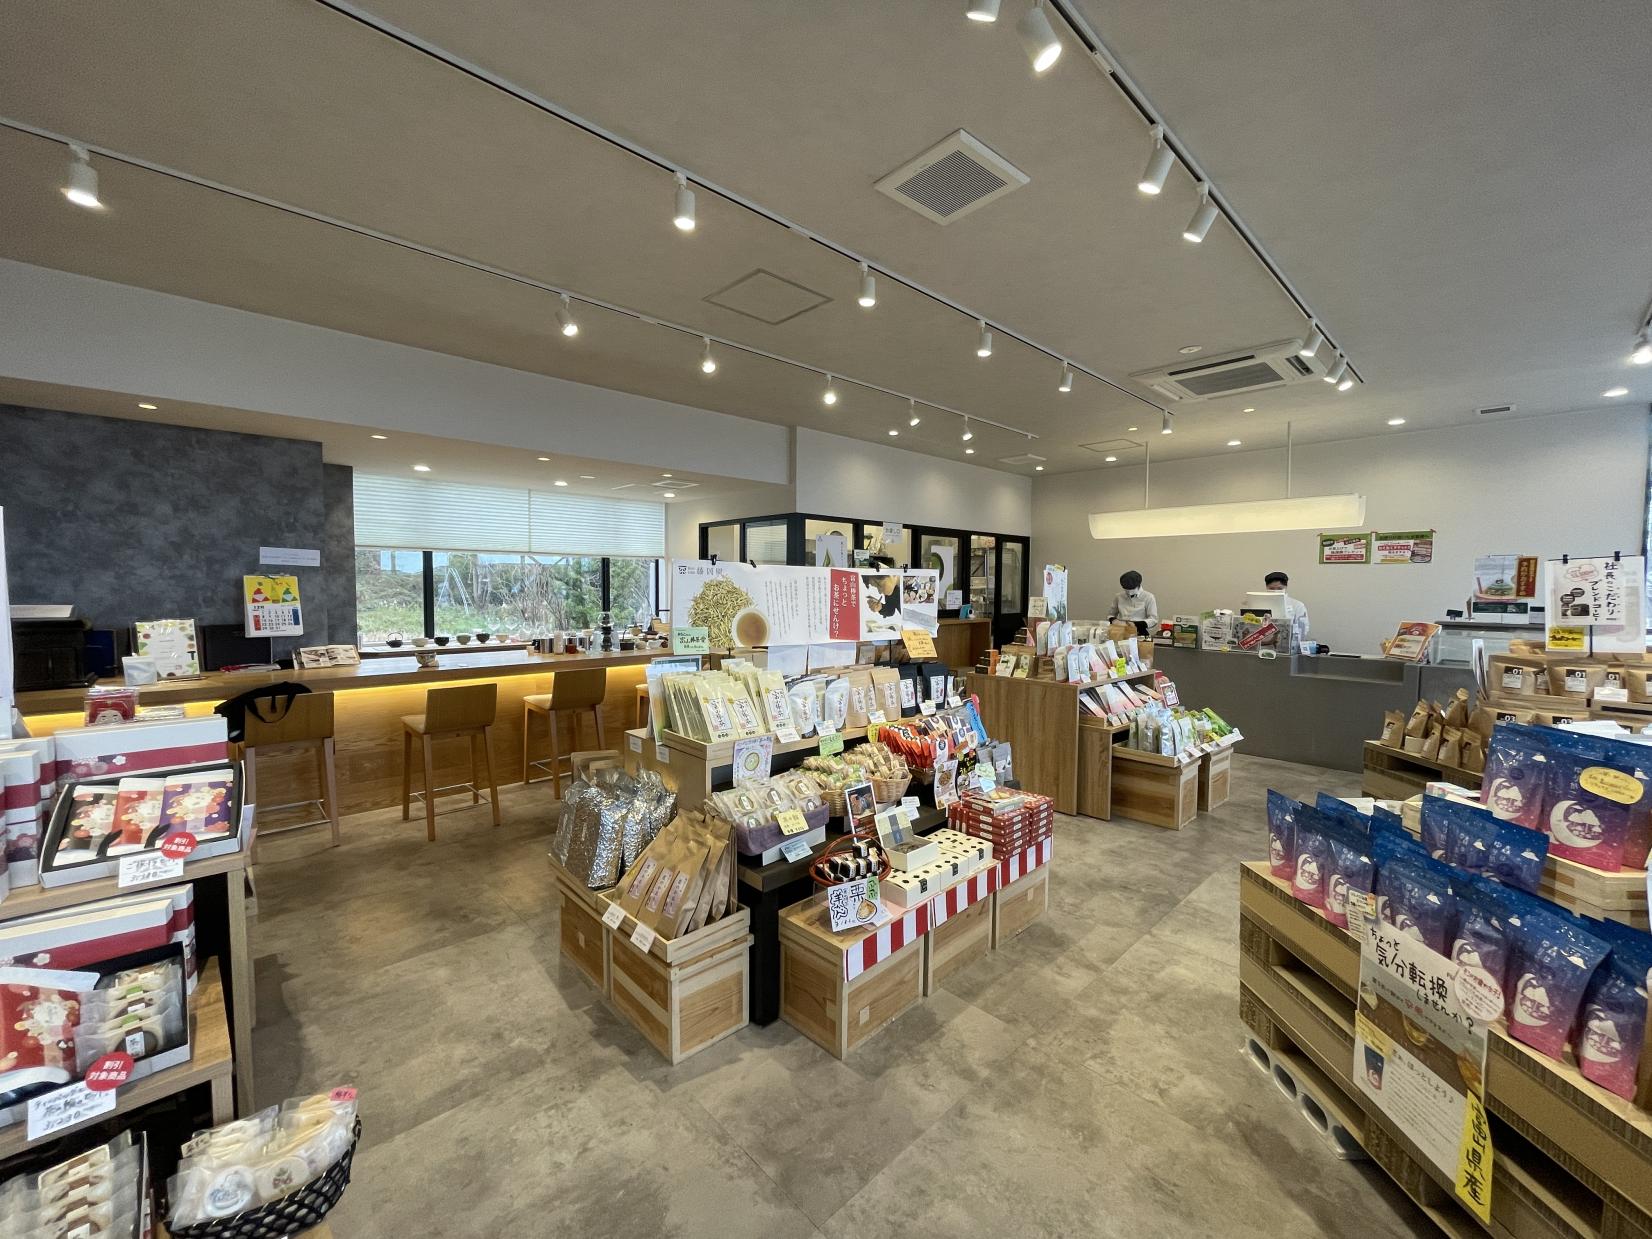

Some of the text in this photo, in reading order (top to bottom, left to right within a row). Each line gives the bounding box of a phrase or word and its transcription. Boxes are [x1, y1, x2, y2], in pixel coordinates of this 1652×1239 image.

[832, 583, 840, 638] お茶にせんけ？
[163, 844, 193, 853] 対象商品
[849, 883, 866, 902] 栗
[1370, 926, 1401, 952] ちょっと
[1375, 943, 1449, 1003] 気分転換
[1416, 990, 1474, 1035] しませんか？
[87, 1071, 128, 1081] 対象商品
